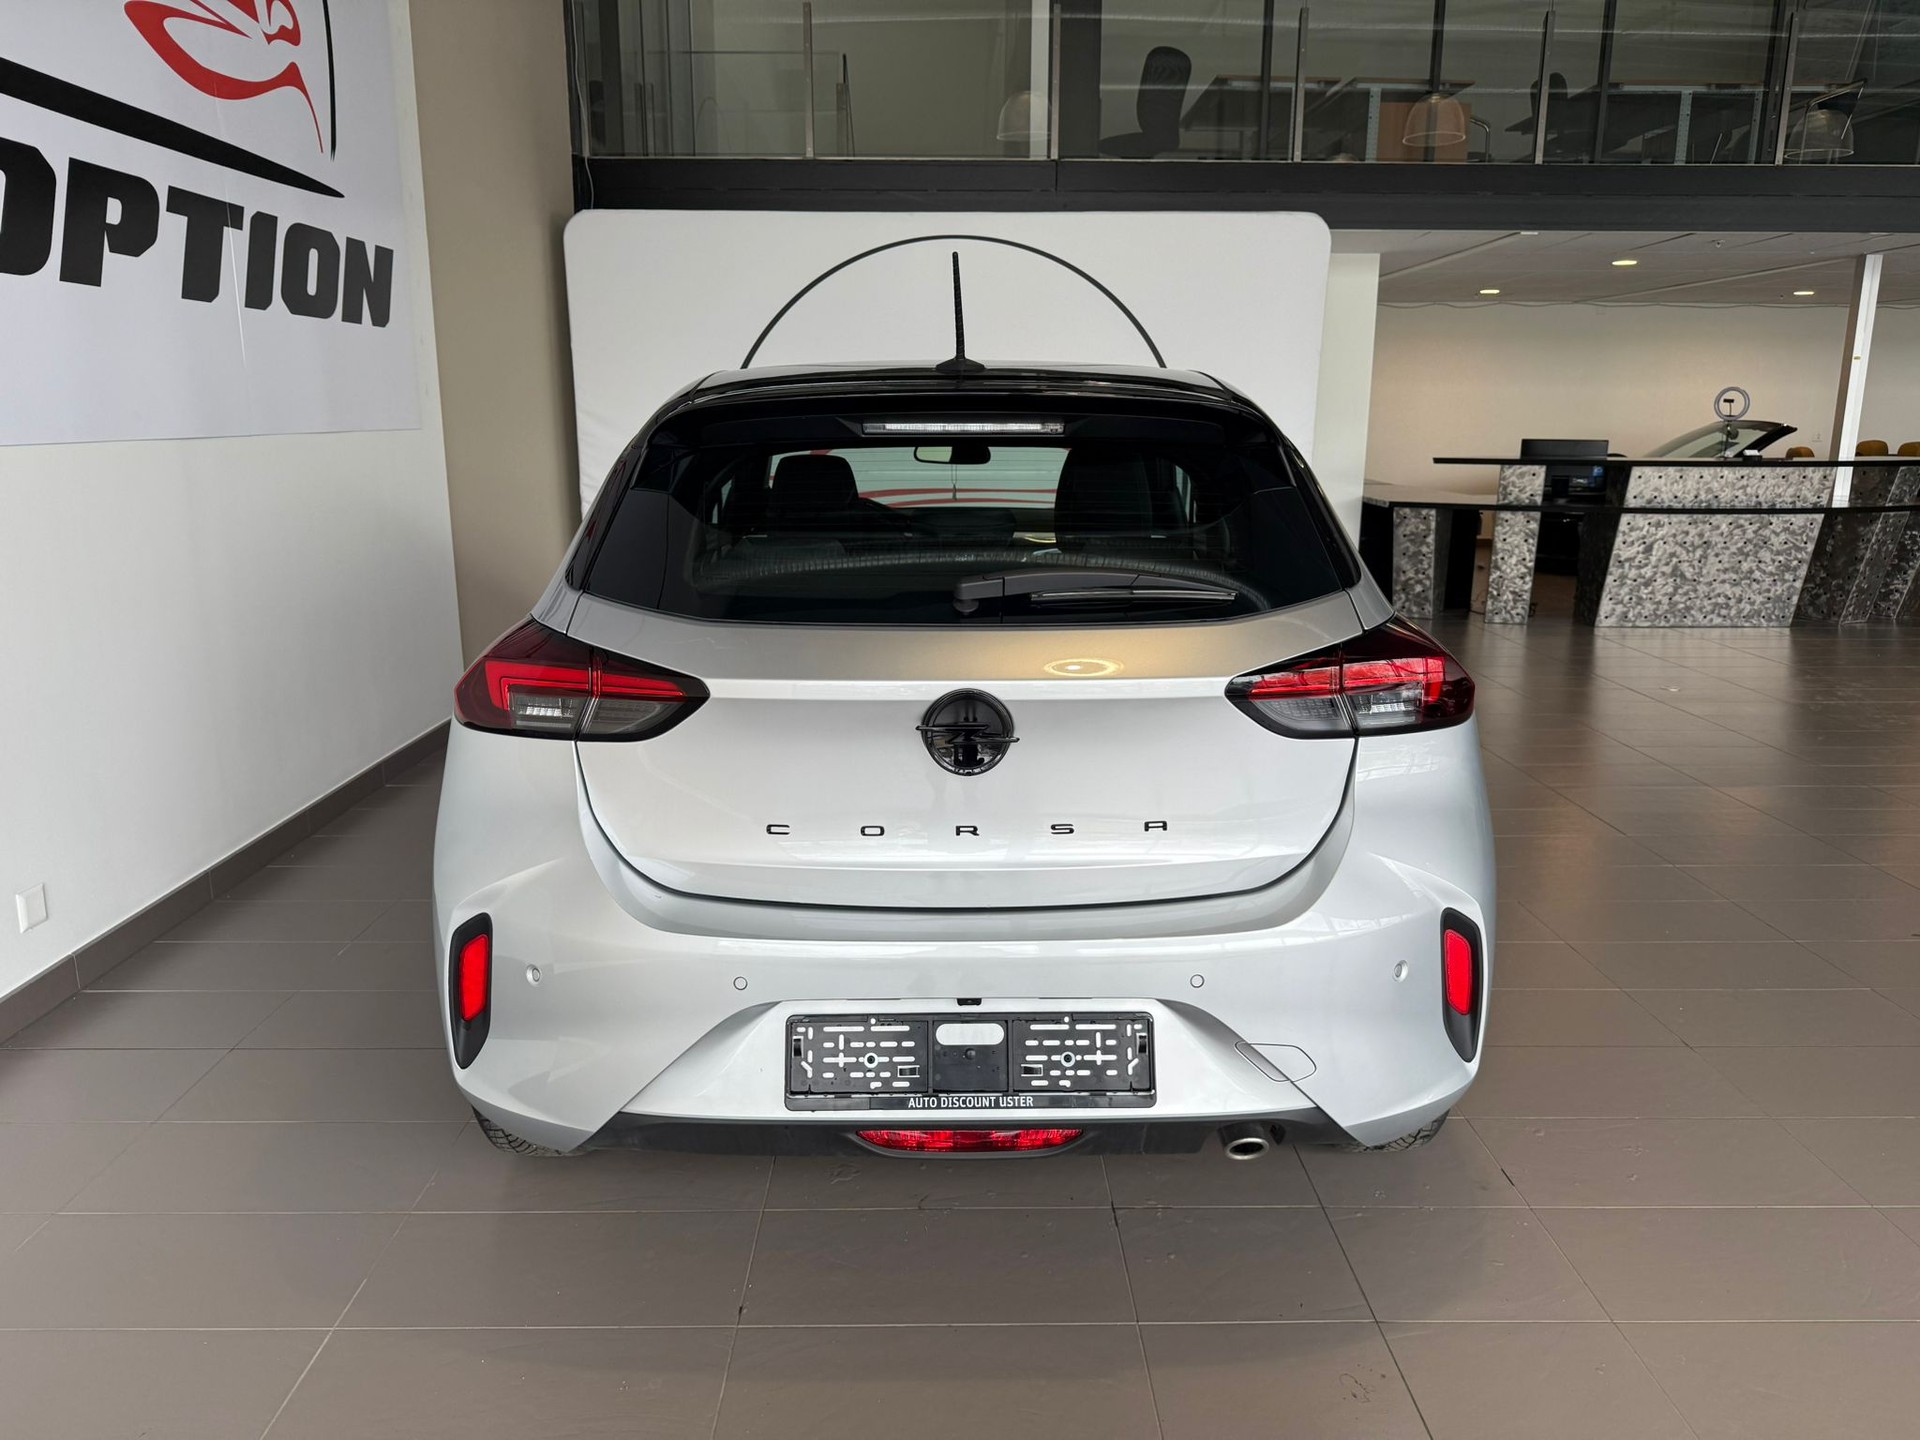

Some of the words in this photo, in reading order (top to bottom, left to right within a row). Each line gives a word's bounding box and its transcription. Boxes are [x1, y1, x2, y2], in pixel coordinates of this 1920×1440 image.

[766, 820, 1168, 837] CORSA
[908, 1097, 937, 1108] AUTO
[940, 1096, 996, 1108] DISCOUNT
[999, 1096, 1034, 1108] USTER
